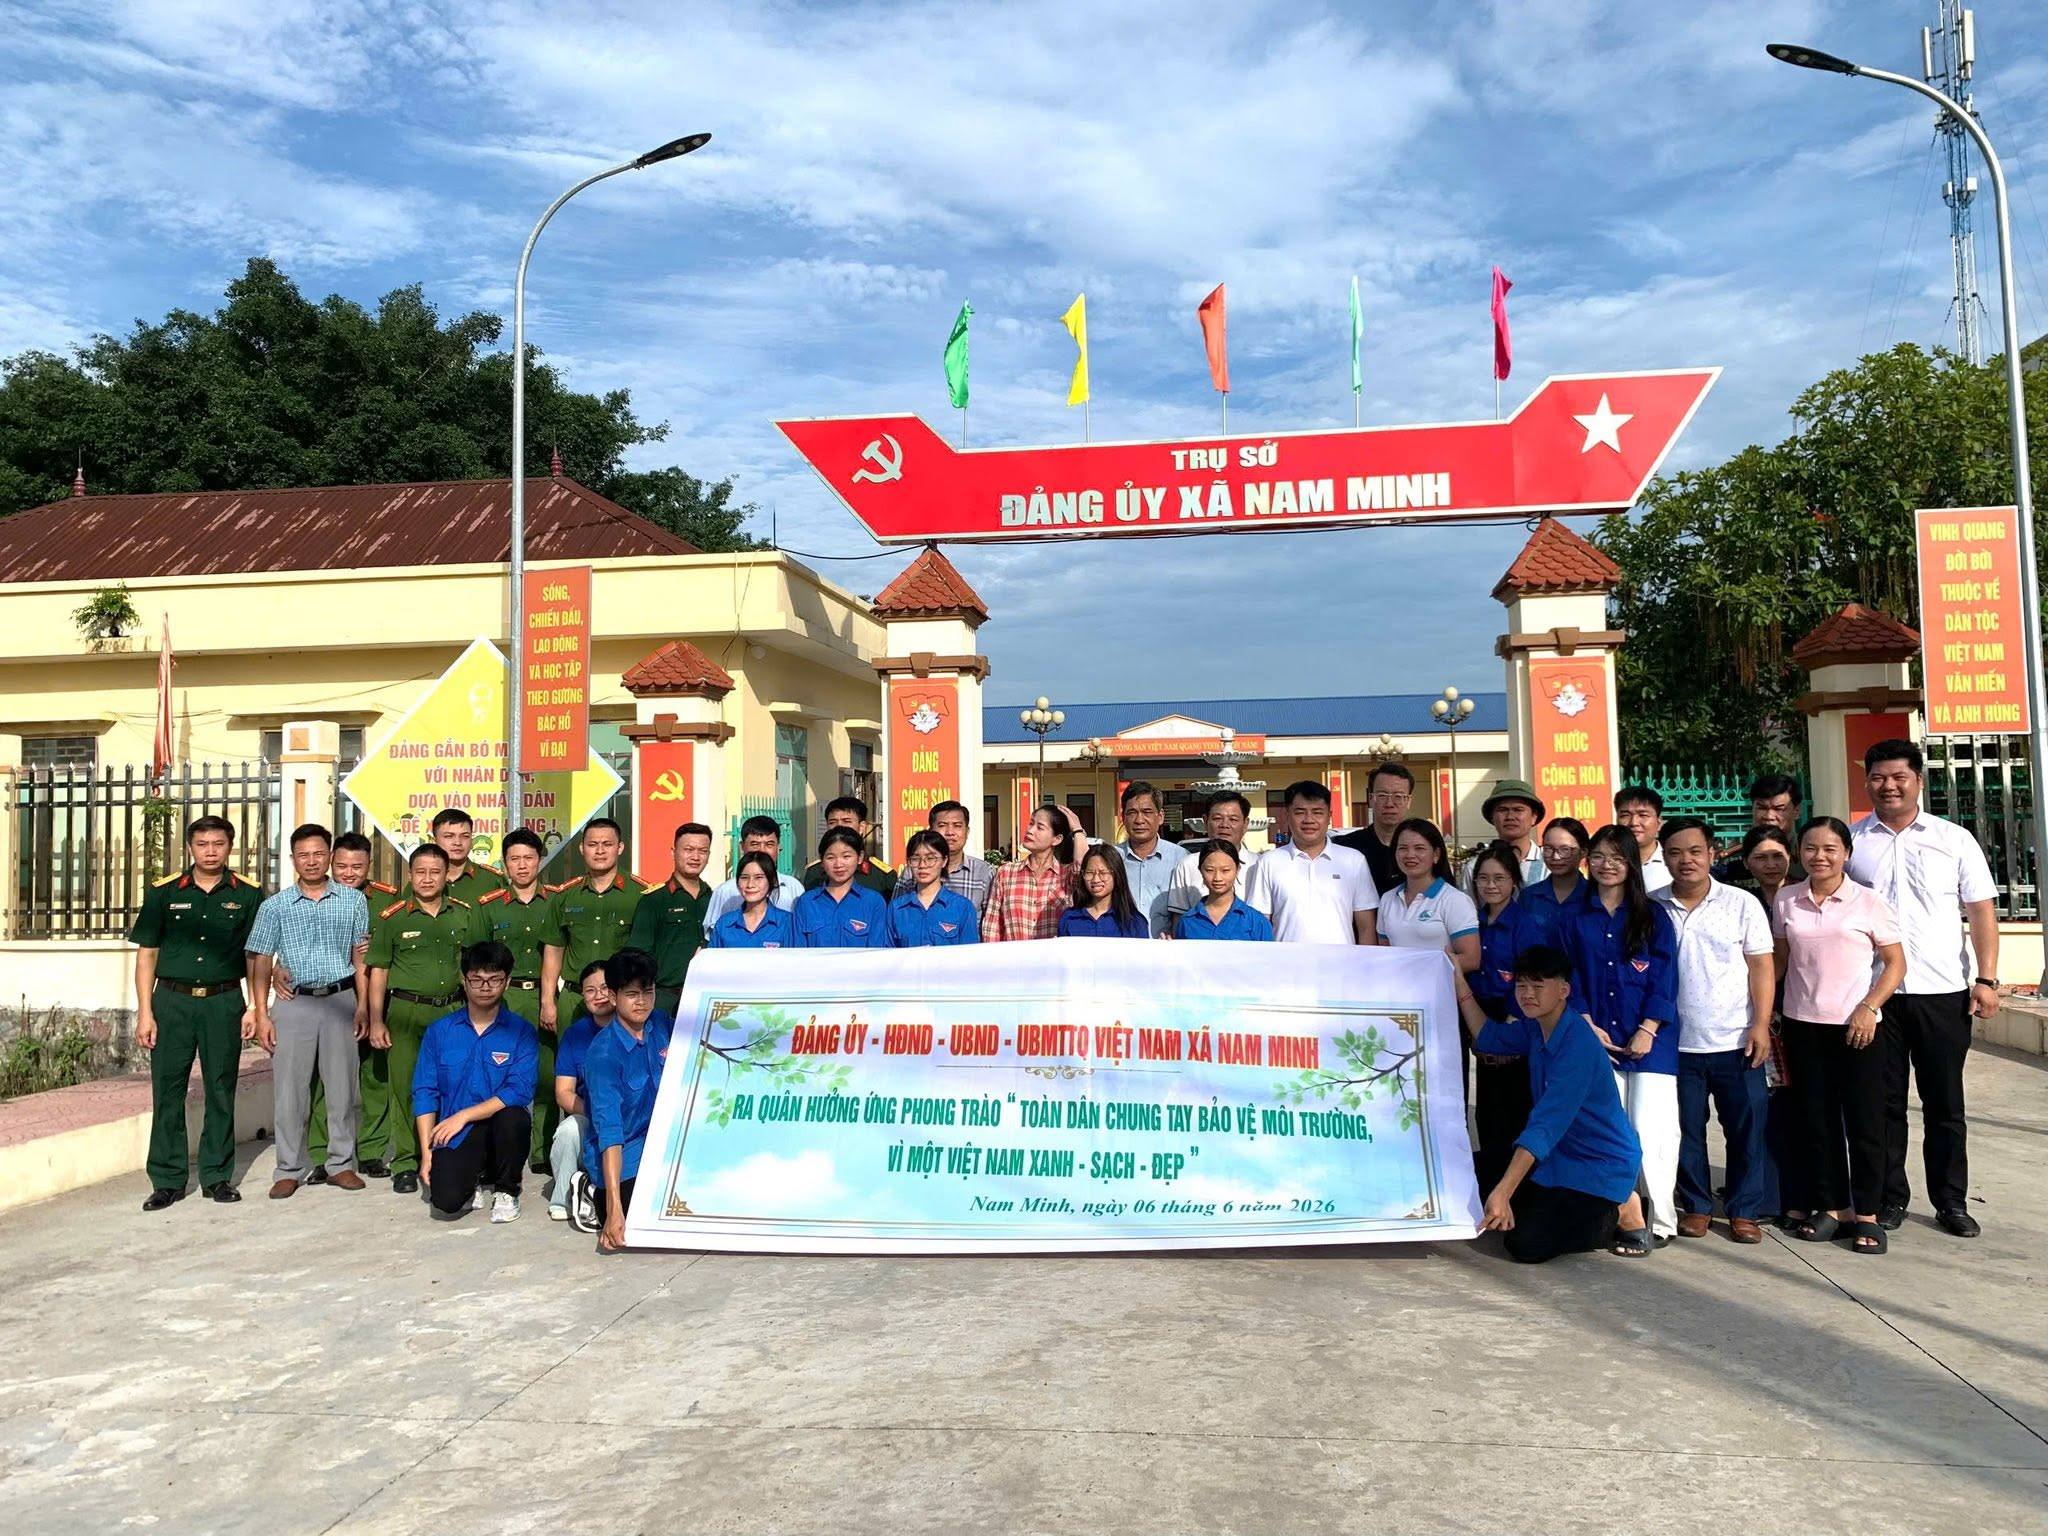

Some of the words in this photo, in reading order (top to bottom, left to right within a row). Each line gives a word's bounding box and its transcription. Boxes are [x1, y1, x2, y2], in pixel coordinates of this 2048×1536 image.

[1171, 448, 1227, 472] TRỤ
[1239, 440, 1278, 468] SỞ
[1000, 485, 1104, 527] ĐẢNG
[1115, 480, 1167, 521] ỦY
[1178, 480, 1234, 519] XÃ
[1243, 479, 1334, 515] NAM
[1347, 472, 1450, 511] MINH
[1929, 523, 1960, 541] VINH
[1963, 521, 2006, 543] QUANG
[1945, 549, 1967, 571] ĐỜI
[542, 580, 570, 601] SỐNG,
[1940, 579, 1982, 605] THUỘC
[562, 604, 583, 627] ĐẤU,
[1945, 611, 1971, 632] DÂN
[1974, 609, 2000, 635] TỘC
[533, 639, 550, 654] LAO
[552, 634, 578, 655] ĐỘNG
[1943, 641, 1970, 666] VIỆT
[1974, 643, 2004, 662] NAM
[529, 661, 541, 680] VÀ
[543, 664, 561, 682] HỌC
[564, 659, 582, 680] TẬP
[1945, 669, 1972, 693] VĂN
[1975, 668, 2006, 692] HIẾN
[527, 690, 549, 707] THEO
[551, 687, 583, 705] GƯƠNG
[537, 713, 556, 732] BÁC
[1934, 701, 1951, 723] VÀ
[1955, 705, 1981, 723] ANH
[1985, 701, 2020, 723] HÙNG
[389, 739, 429, 758] ĐẢNG
[435, 737, 465, 758] GẮN
[470, 739, 489, 757] BÓ
[551, 741, 567, 760] ĐẠI
[1553, 729, 1589, 753] NƯỚC
[912, 744, 939, 773] ĐẢNG
[424, 765, 447, 783] VỚI
[452, 765, 494, 783] NHÂN
[500, 767, 535, 784] DN,
[1541, 762, 1577, 790] CỘNG
[1579, 760, 1605, 785] HÒA
[408, 792, 437, 812] DỰA
[443, 790, 471, 808] VÀO
[476, 790, 508, 808] NHÂ
[523, 789, 555, 808] DÂN
[901, 784, 928, 815] CỘNG
[1554, 796, 1572, 818] XÃ
[1574, 795, 1596, 823] HỘI
[791, 1015, 841, 1055] ĐẢNG
[843, 1013, 868, 1055] ỦY
[883, 1023, 933, 1055] HĐND
[950, 1024, 999, 1056] UBND
[1016, 1024, 1089, 1061] UBMTTQ
[1094, 1020, 1133, 1066] VIỆT
[1138, 1028, 1181, 1061] NAM
[1187, 1025, 1212, 1063] XÃ
[1218, 1032, 1262, 1066] NAM
[1268, 1035, 1319, 1069] MINH
[732, 1094, 754, 1120] RA
[758, 1090, 802, 1124] QUÂN
[805, 1087, 860, 1123] HƯỞNG
[863, 1091, 897, 1124] ỨNG
[900, 1097, 956, 1126] PHONG
[961, 1093, 1001, 1127] TRÀO
[1020, 1094, 1062, 1128] TOÀN
[1067, 1095, 1100, 1129] DÂN
[1105, 1102, 1161, 1131] CHUNG
[1167, 1104, 1193, 1132] TAY
[1199, 1096, 1231, 1133] BẢO
[1236, 1102, 1257, 1141] VỆ
[1262, 1104, 1294, 1137] MÔI
[1299, 1106, 1373, 1143] TRƯỜNG,
[888, 1139, 903, 1172] VÌ
[907, 1140, 944, 1179] MỘT
[948, 1141, 982, 1180] VIỆT
[985, 1148, 1025, 1176] NAM
[1028, 1149, 1074, 1178] XANH
[1090, 1151, 1135, 1184] SẠCH
[1151, 1152, 1185, 1186] ĐẸP
[969, 1196, 1014, 1212] Nam
[1019, 1197, 1075, 1215] Minh,
[1082, 1199, 1128, 1217] ngày
[1133, 1199, 1156, 1214] 06
[1161, 1199, 1217, 1217] tháng
[1223, 1200, 1233, 1214] 6
[1239, 1200, 1282, 1212] năm
[1289, 1198, 1336, 1214] 2026
